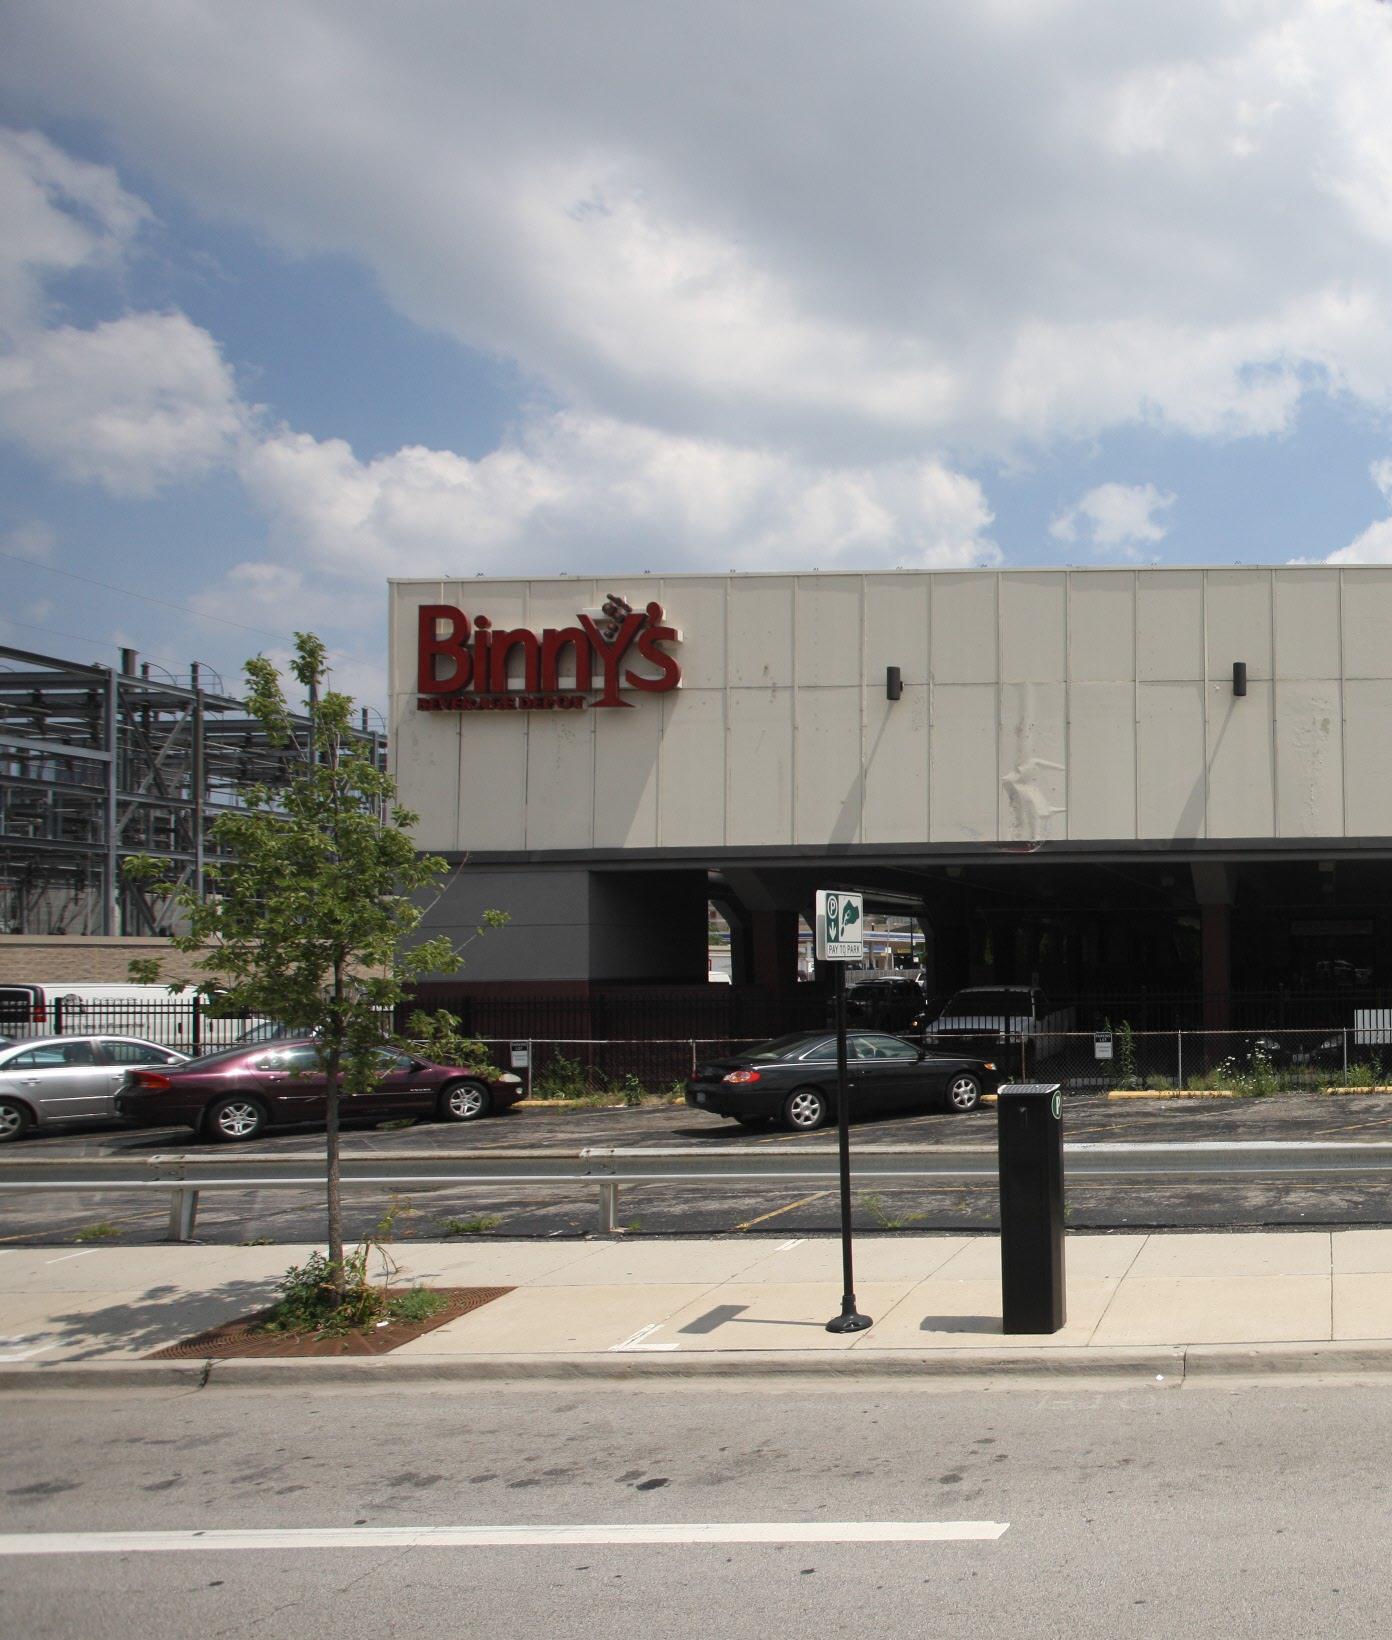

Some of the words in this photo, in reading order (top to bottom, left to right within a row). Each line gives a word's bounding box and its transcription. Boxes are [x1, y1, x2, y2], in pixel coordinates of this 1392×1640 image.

[828, 945, 838, 954] PAY
[839, 946, 846, 955] TO
[846, 945, 860, 954] PARK
